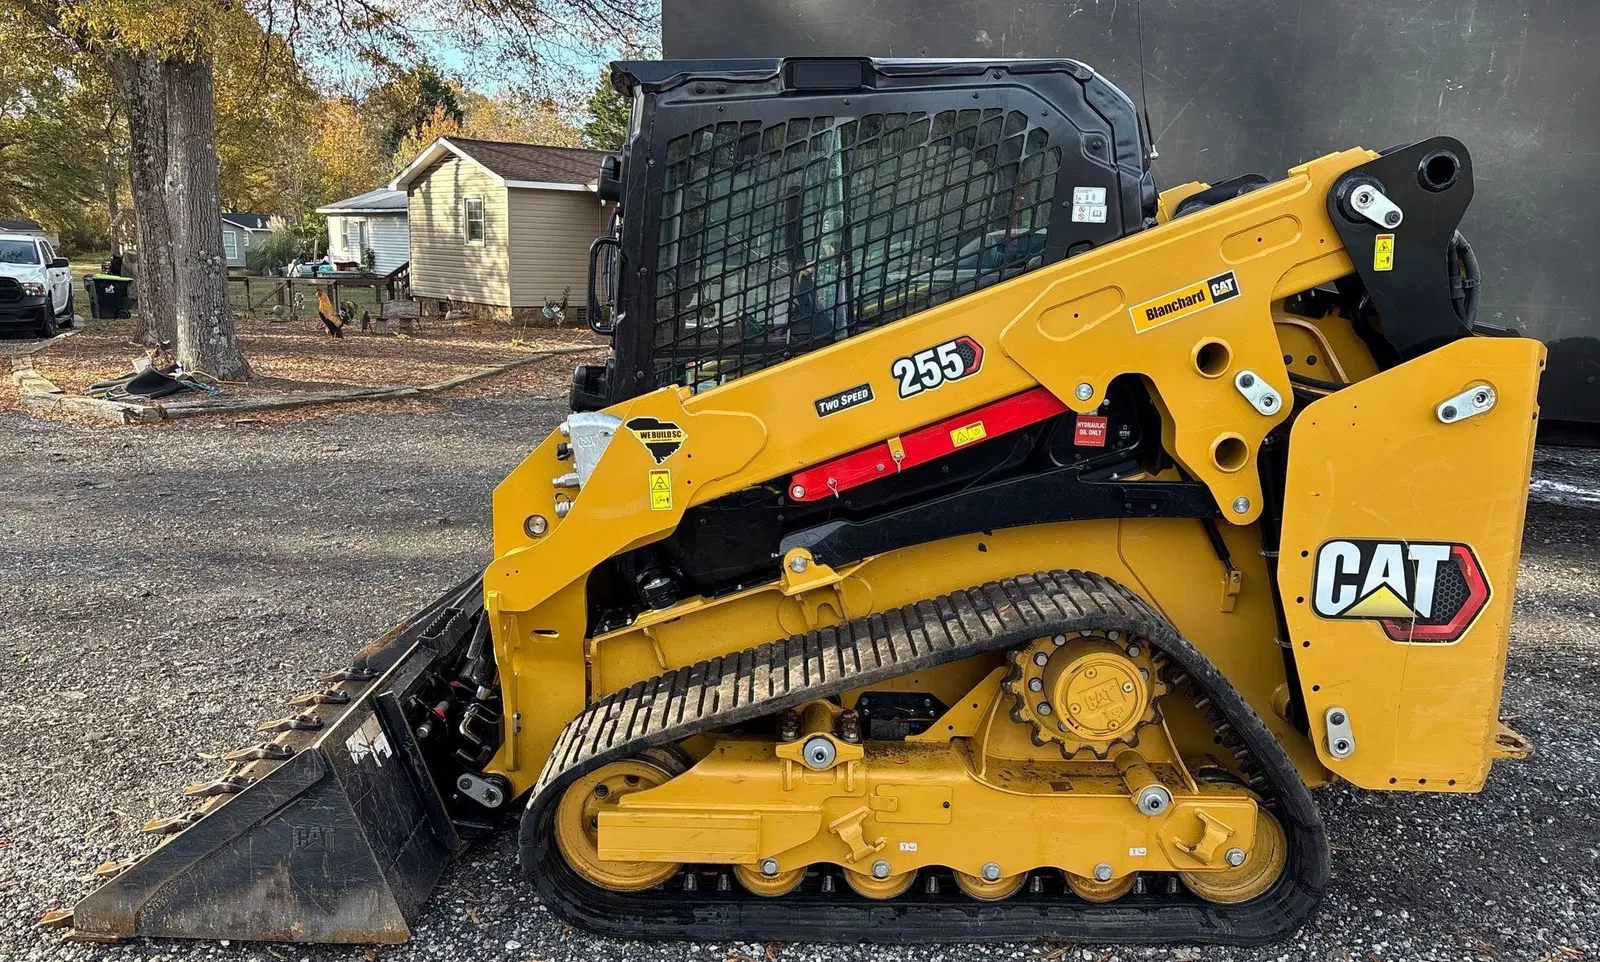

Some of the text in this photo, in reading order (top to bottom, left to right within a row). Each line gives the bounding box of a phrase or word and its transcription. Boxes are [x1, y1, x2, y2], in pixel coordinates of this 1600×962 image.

[1145, 278, 1234, 321] Blanchard CAT
[893, 341, 965, 397] 255
[640, 430, 682, 439] WE BUILD SC
[1315, 541, 1451, 618] CAT
[1084, 684, 1115, 711] CAT
[293, 825, 336, 852] CAT
